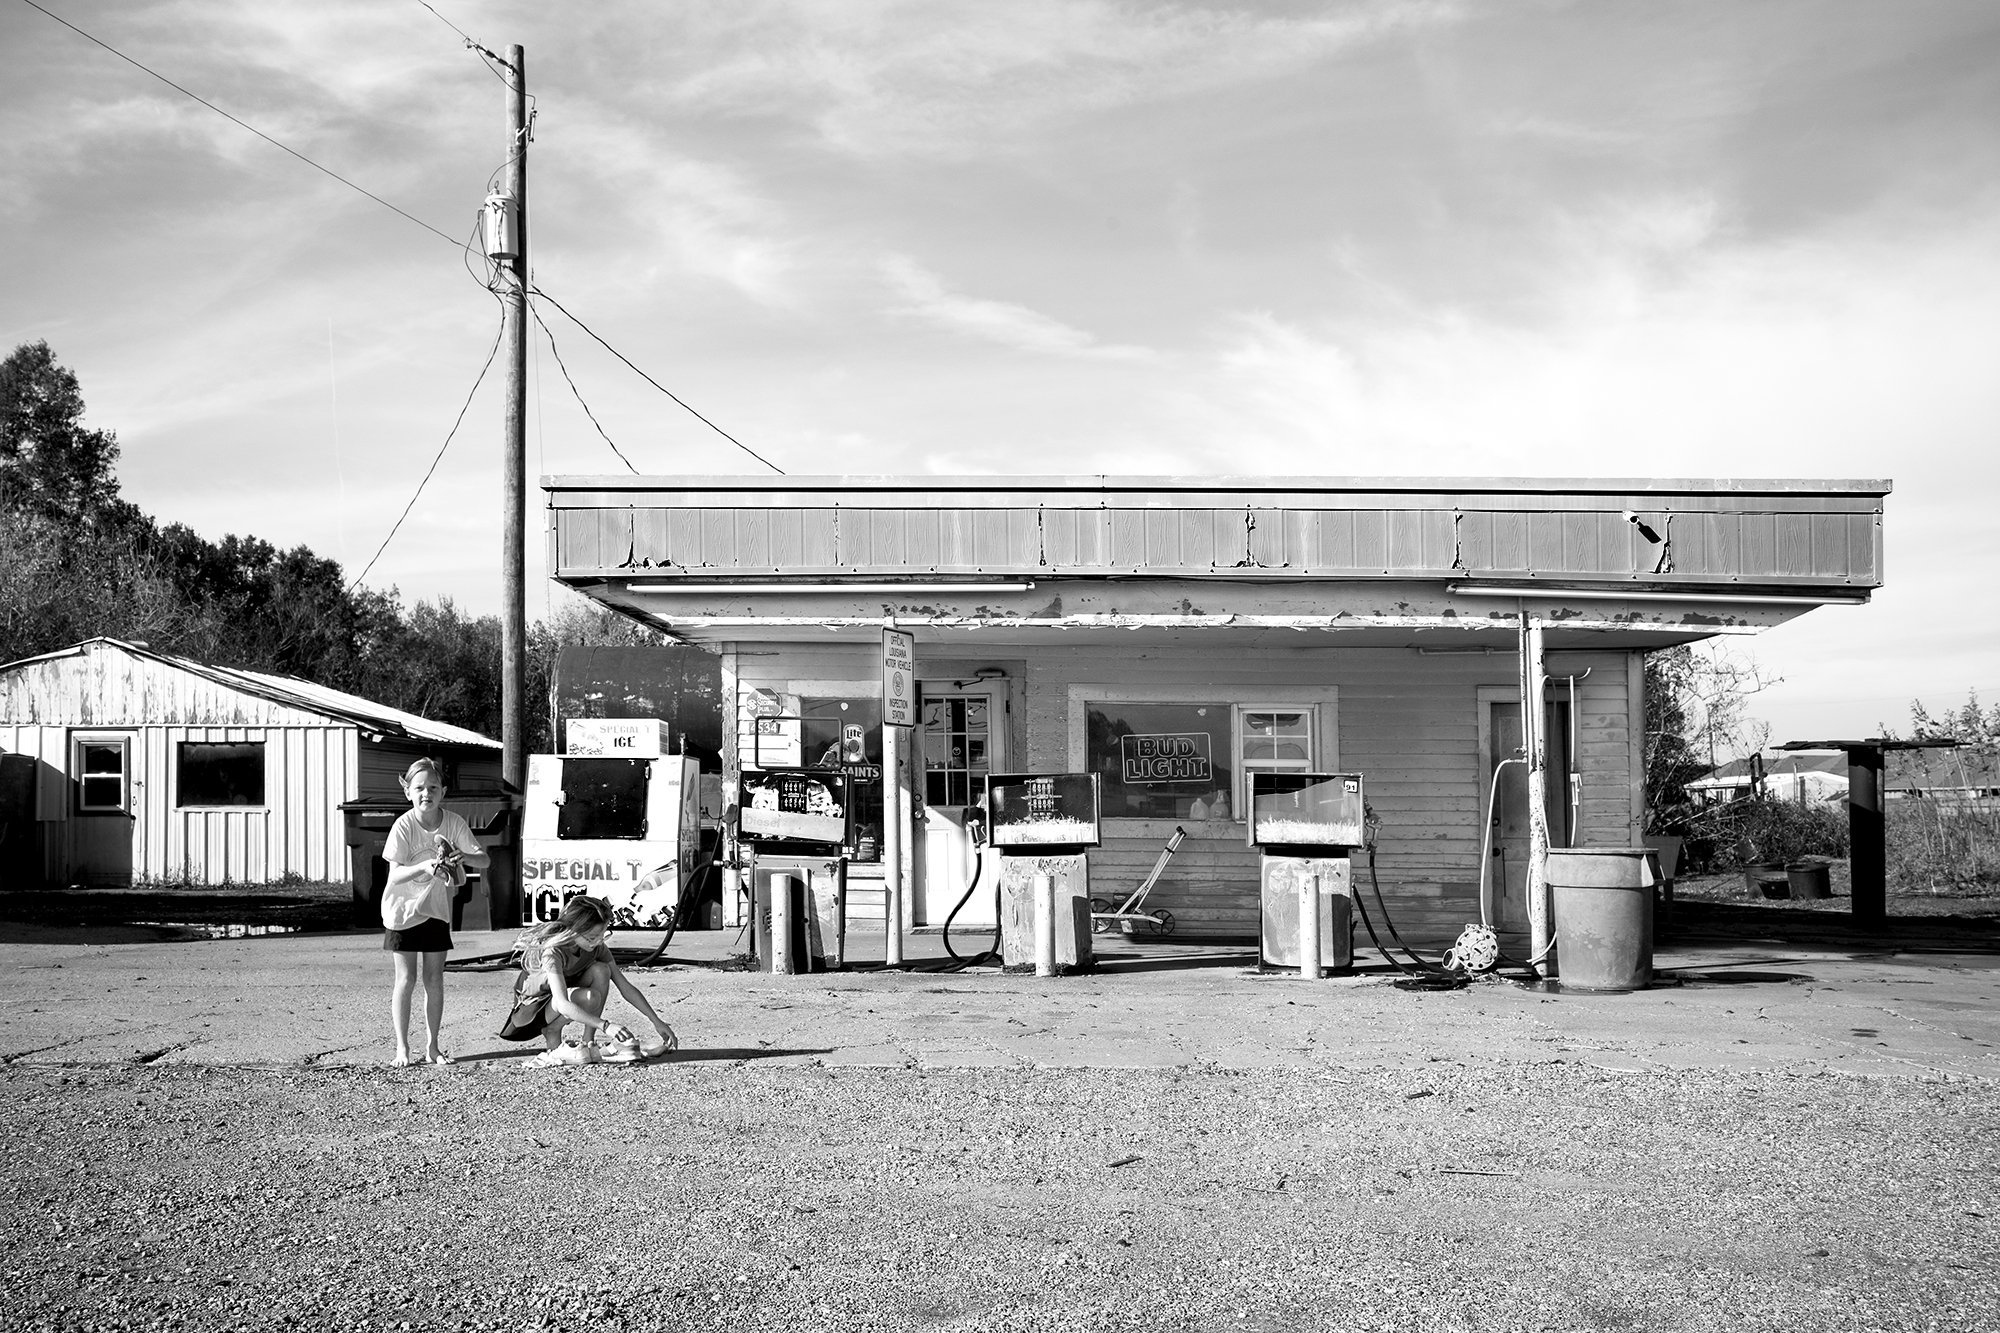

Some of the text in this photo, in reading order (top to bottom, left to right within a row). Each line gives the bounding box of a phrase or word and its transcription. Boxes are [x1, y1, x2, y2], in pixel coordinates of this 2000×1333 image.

[890, 634, 905, 647] OFFICIAL
[888, 646, 907, 658] LOUISIANA
[885, 658, 912, 671] MOTOR VEHICLE
[888, 698, 908, 709] INSPECTION
[892, 709, 905, 720] STATION
[599, 725, 639, 734] SPECIAL
[750, 722, 778, 733] 4534
[846, 729, 862, 739] Lite
[613, 735, 636, 748] ICE
[1137, 737, 1196, 758] BUD
[841, 766, 880, 778] SAINTS
[743, 812, 780, 829] Diesel
[523, 858, 643, 881] SPECIAL T
